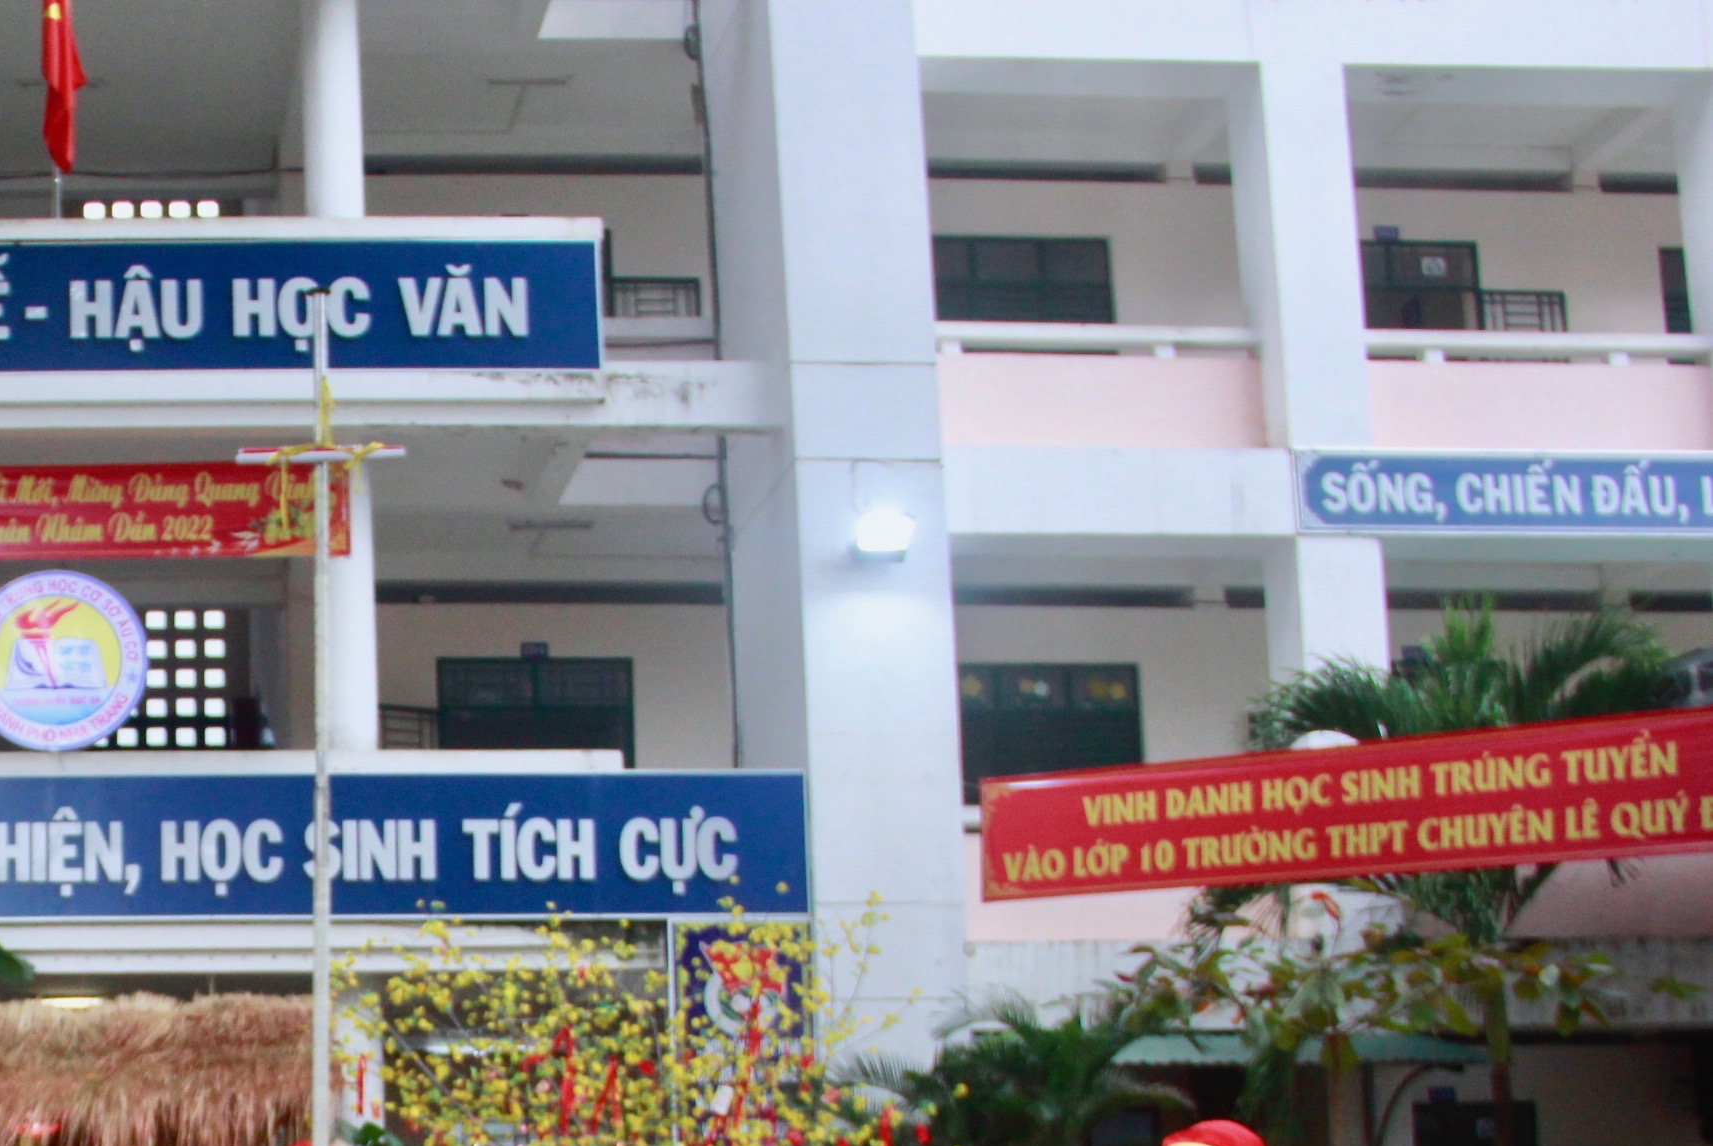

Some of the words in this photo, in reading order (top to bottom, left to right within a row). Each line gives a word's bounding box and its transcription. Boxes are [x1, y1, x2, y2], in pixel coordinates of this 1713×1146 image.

[69, 265, 203, 352] HẬU
[232, 277, 371, 352] HỌC
[397, 264, 528, 337] VĂN
[195, 471, 260, 507] Quang
[1320, 459, 1448, 523] SỐNG,
[1455, 458, 1583, 516] CHIẾN
[1591, 458, 1690, 523] ĐẤU,
[36, 514, 103, 543] Nhâm
[161, 515, 213, 541] 2022
[49, 579, 77, 593] HỌC
[1082, 790, 1157, 827] VINH
[1165, 780, 1253, 819] DANH
[1261, 773, 1332, 815] HỌC
[1340, 765, 1421, 805] SINH
[1429, 750, 1552, 796] TRÚNG
[1561, 728, 1678, 785] TUYỂN
[160, 818, 283, 896] HỌC
[303, 818, 437, 881] SINH
[462, 802, 594, 880] TÍCH
[619, 805, 738, 894] CỰC
[1002, 843, 1066, 882] VÀO
[1073, 838, 1129, 878] LỚP
[1139, 839, 1176, 872] 10
[1181, 825, 1317, 869] TRƯỜNG
[1326, 819, 1409, 858] THPT
[1417, 803, 1554, 851] CHUYÊN
[1565, 798, 1601, 841] LÊ
[1610, 789, 1688, 840] QUÝ
